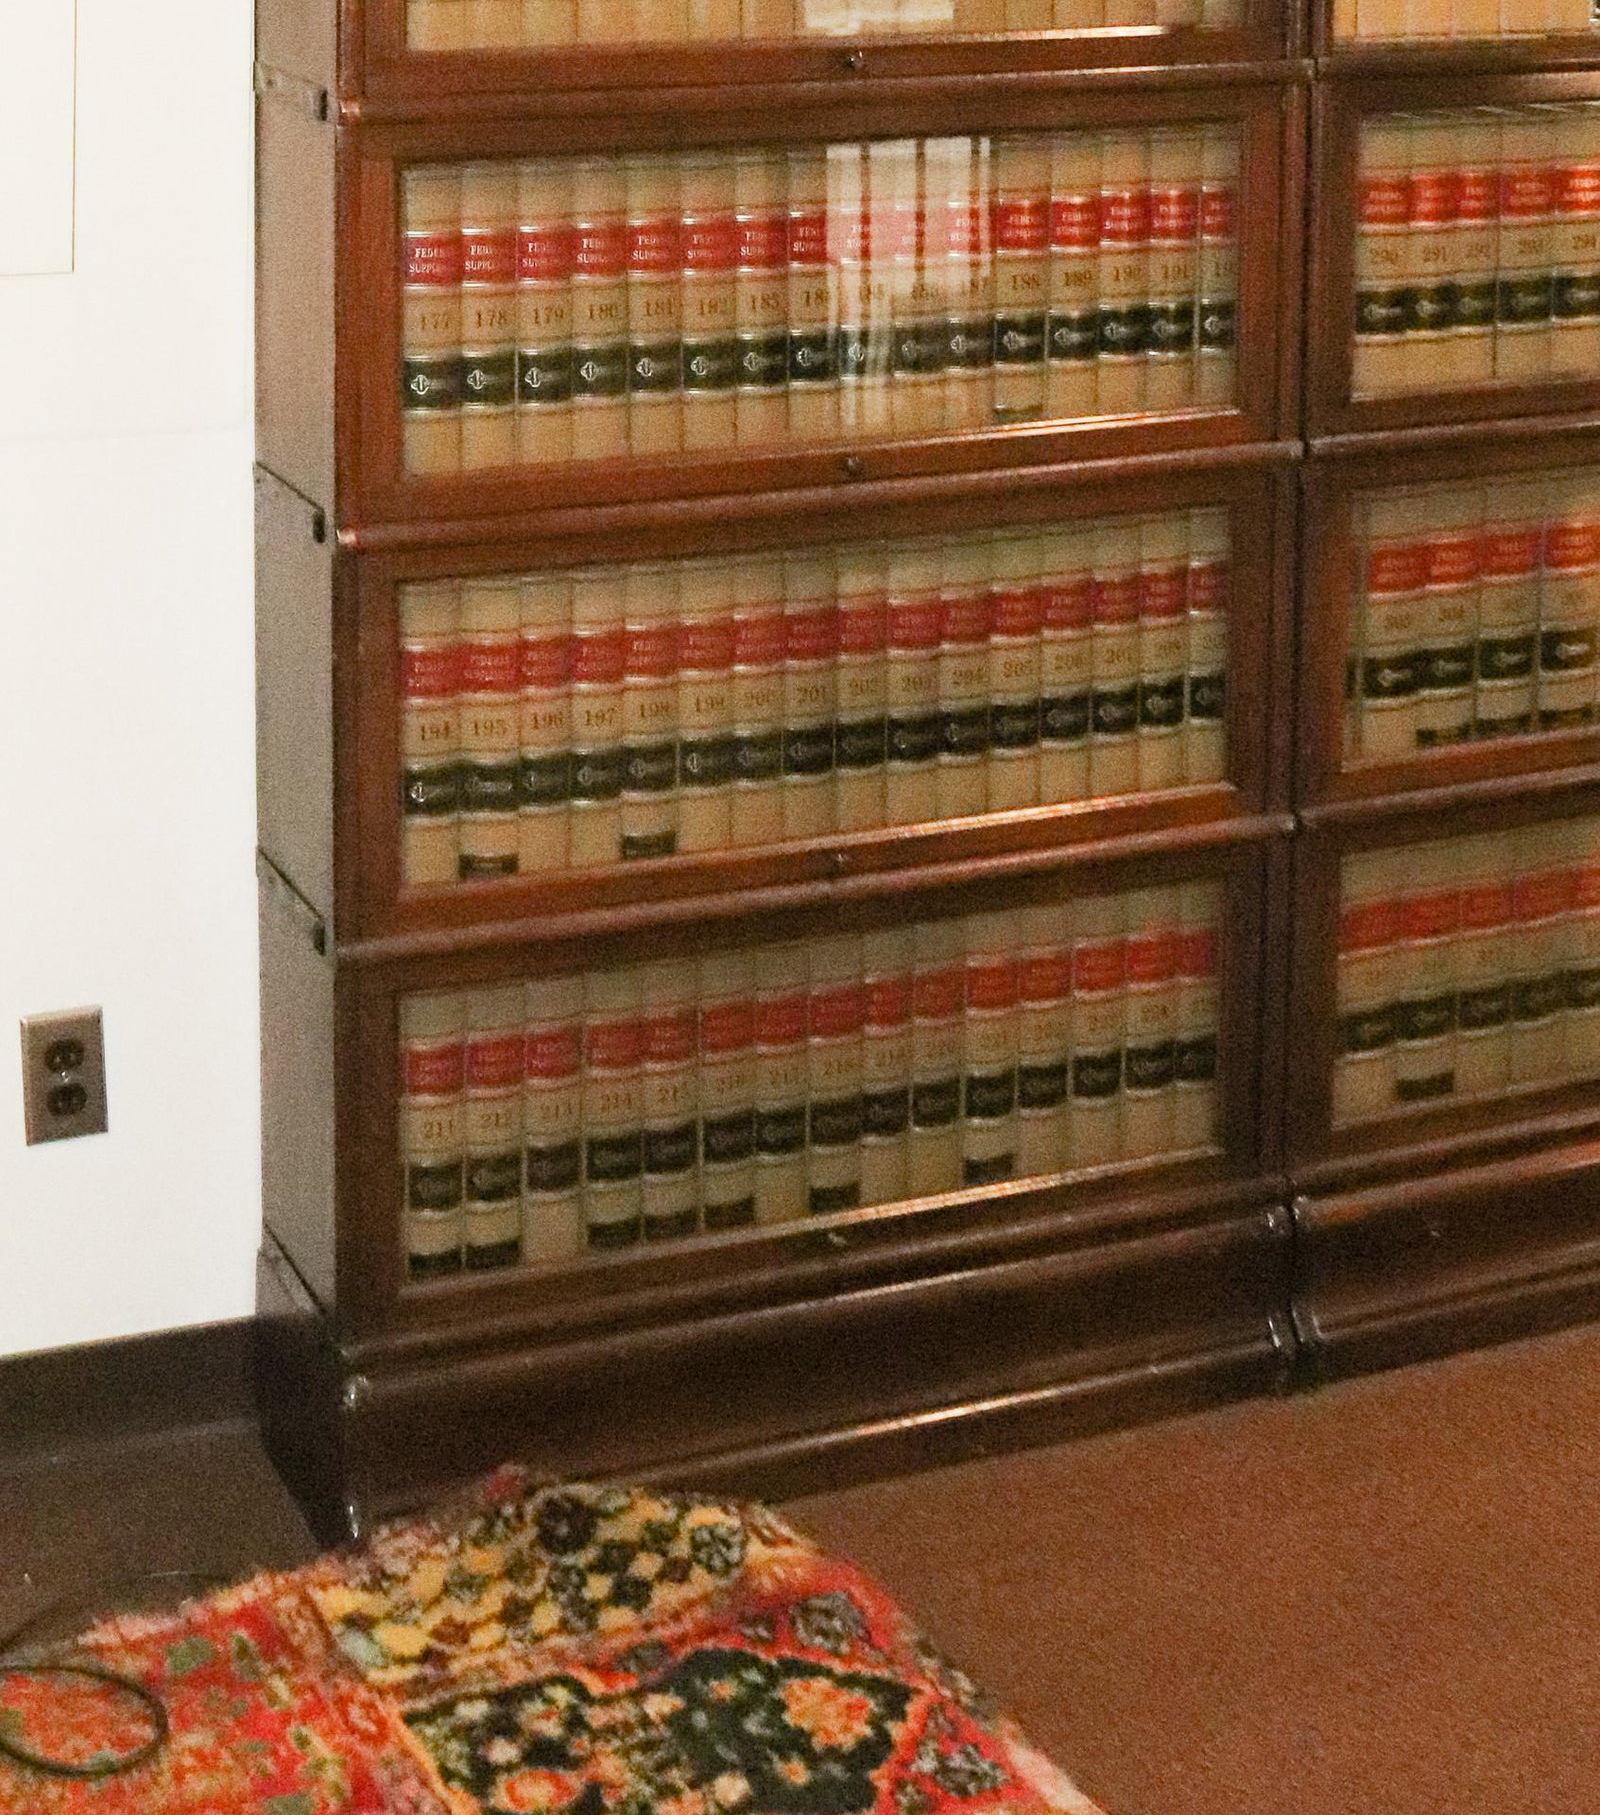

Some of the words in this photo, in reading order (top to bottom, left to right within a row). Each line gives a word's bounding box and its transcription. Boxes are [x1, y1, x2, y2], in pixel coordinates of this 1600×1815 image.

[1010, 273, 1040, 291] 188
[533, 307, 564, 325] 179
[588, 303, 618, 321] 180
[644, 297, 675, 317] 181
[475, 308, 508, 328] 178
